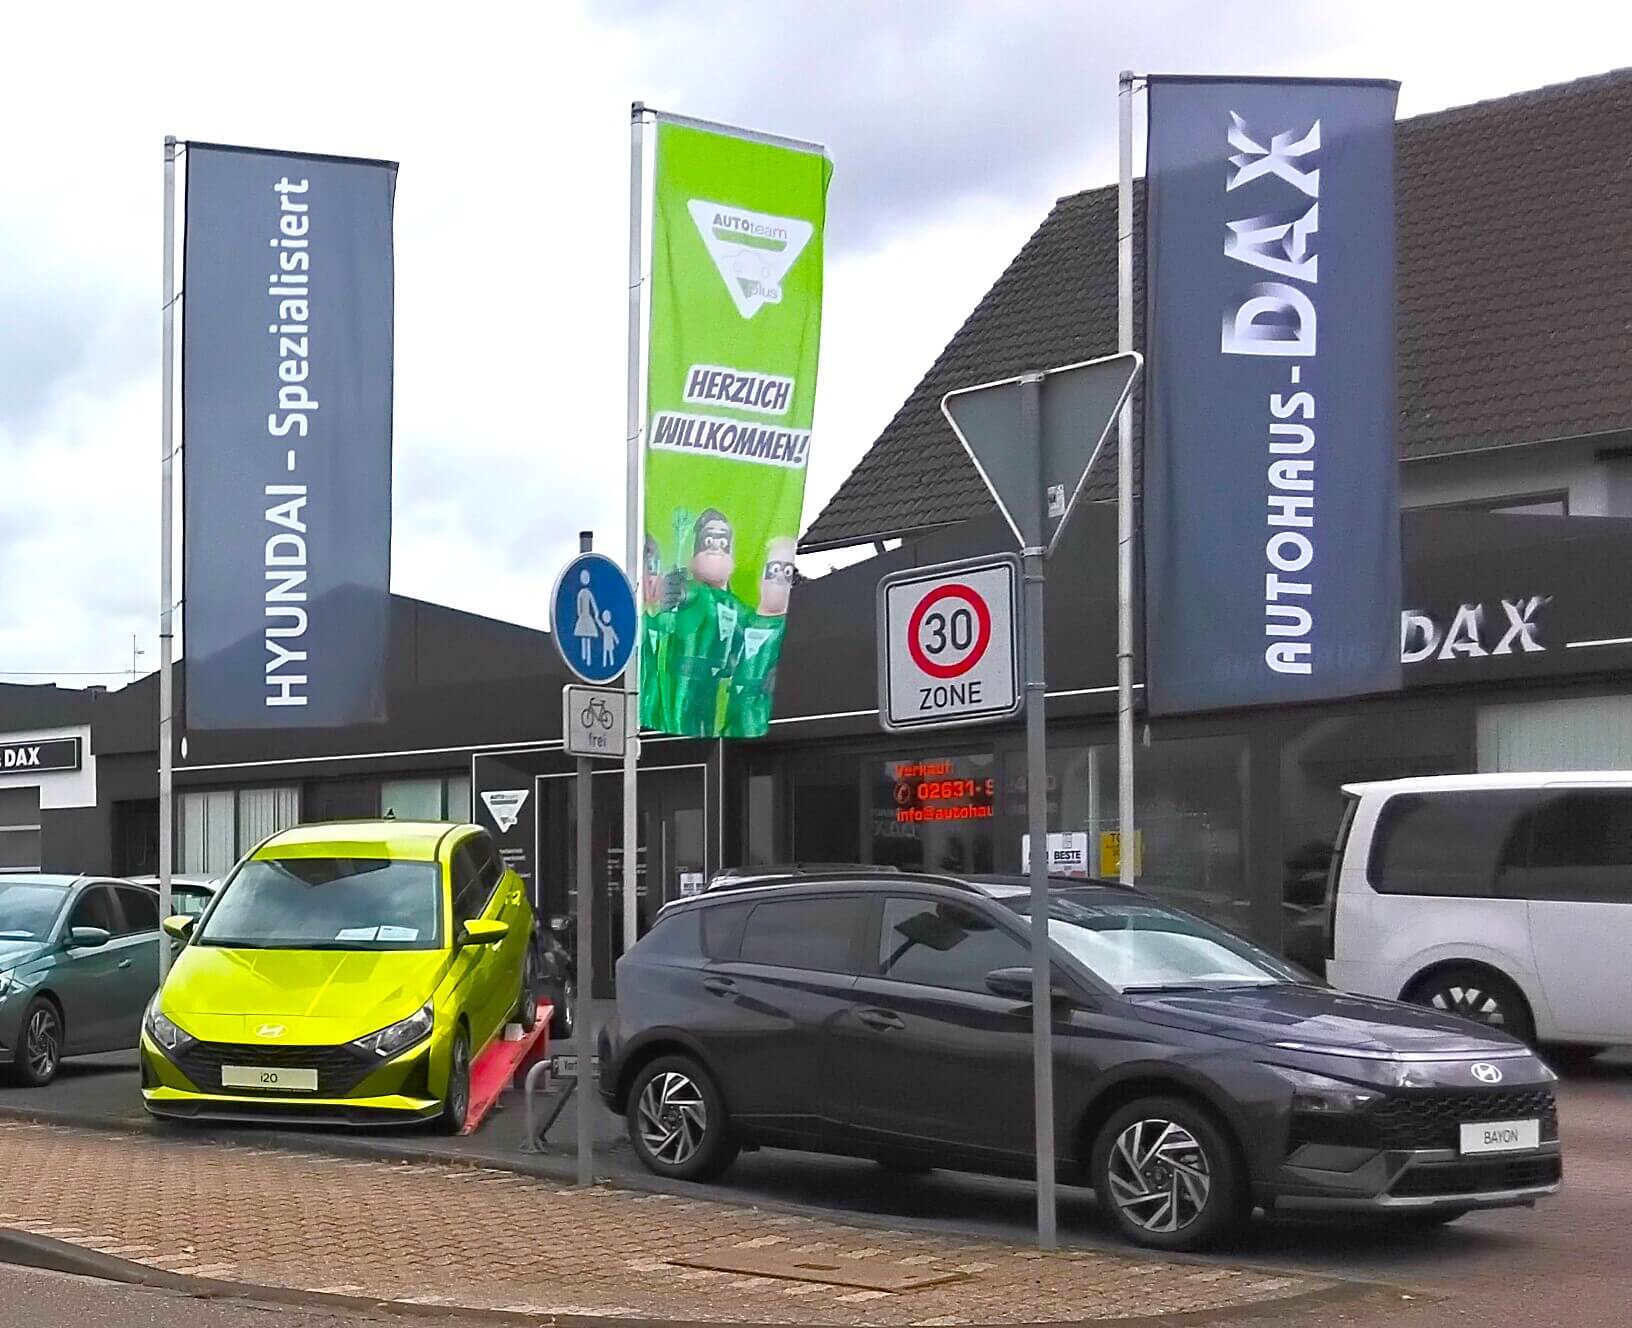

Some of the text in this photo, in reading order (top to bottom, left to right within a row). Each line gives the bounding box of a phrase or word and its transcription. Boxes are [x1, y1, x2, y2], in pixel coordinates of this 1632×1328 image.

[268, 177, 319, 437] Spezialisiert
[688, 369, 791, 410] HERZLICH
[653, 415, 809, 464] WILLKOMMEN!
[265, 485, 308, 707] HYUNDAI
[924, 608, 973, 655] 30
[1400, 595, 1552, 664] DAX
[919, 682, 983, 711] ZONE
[588, 731, 607, 748] frei
[4, 747, 41, 768] DAX
[1054, 850, 1081, 860] BESTE
[260, 1072, 278, 1084] i20
[1483, 1129, 1519, 1145] BAYON
